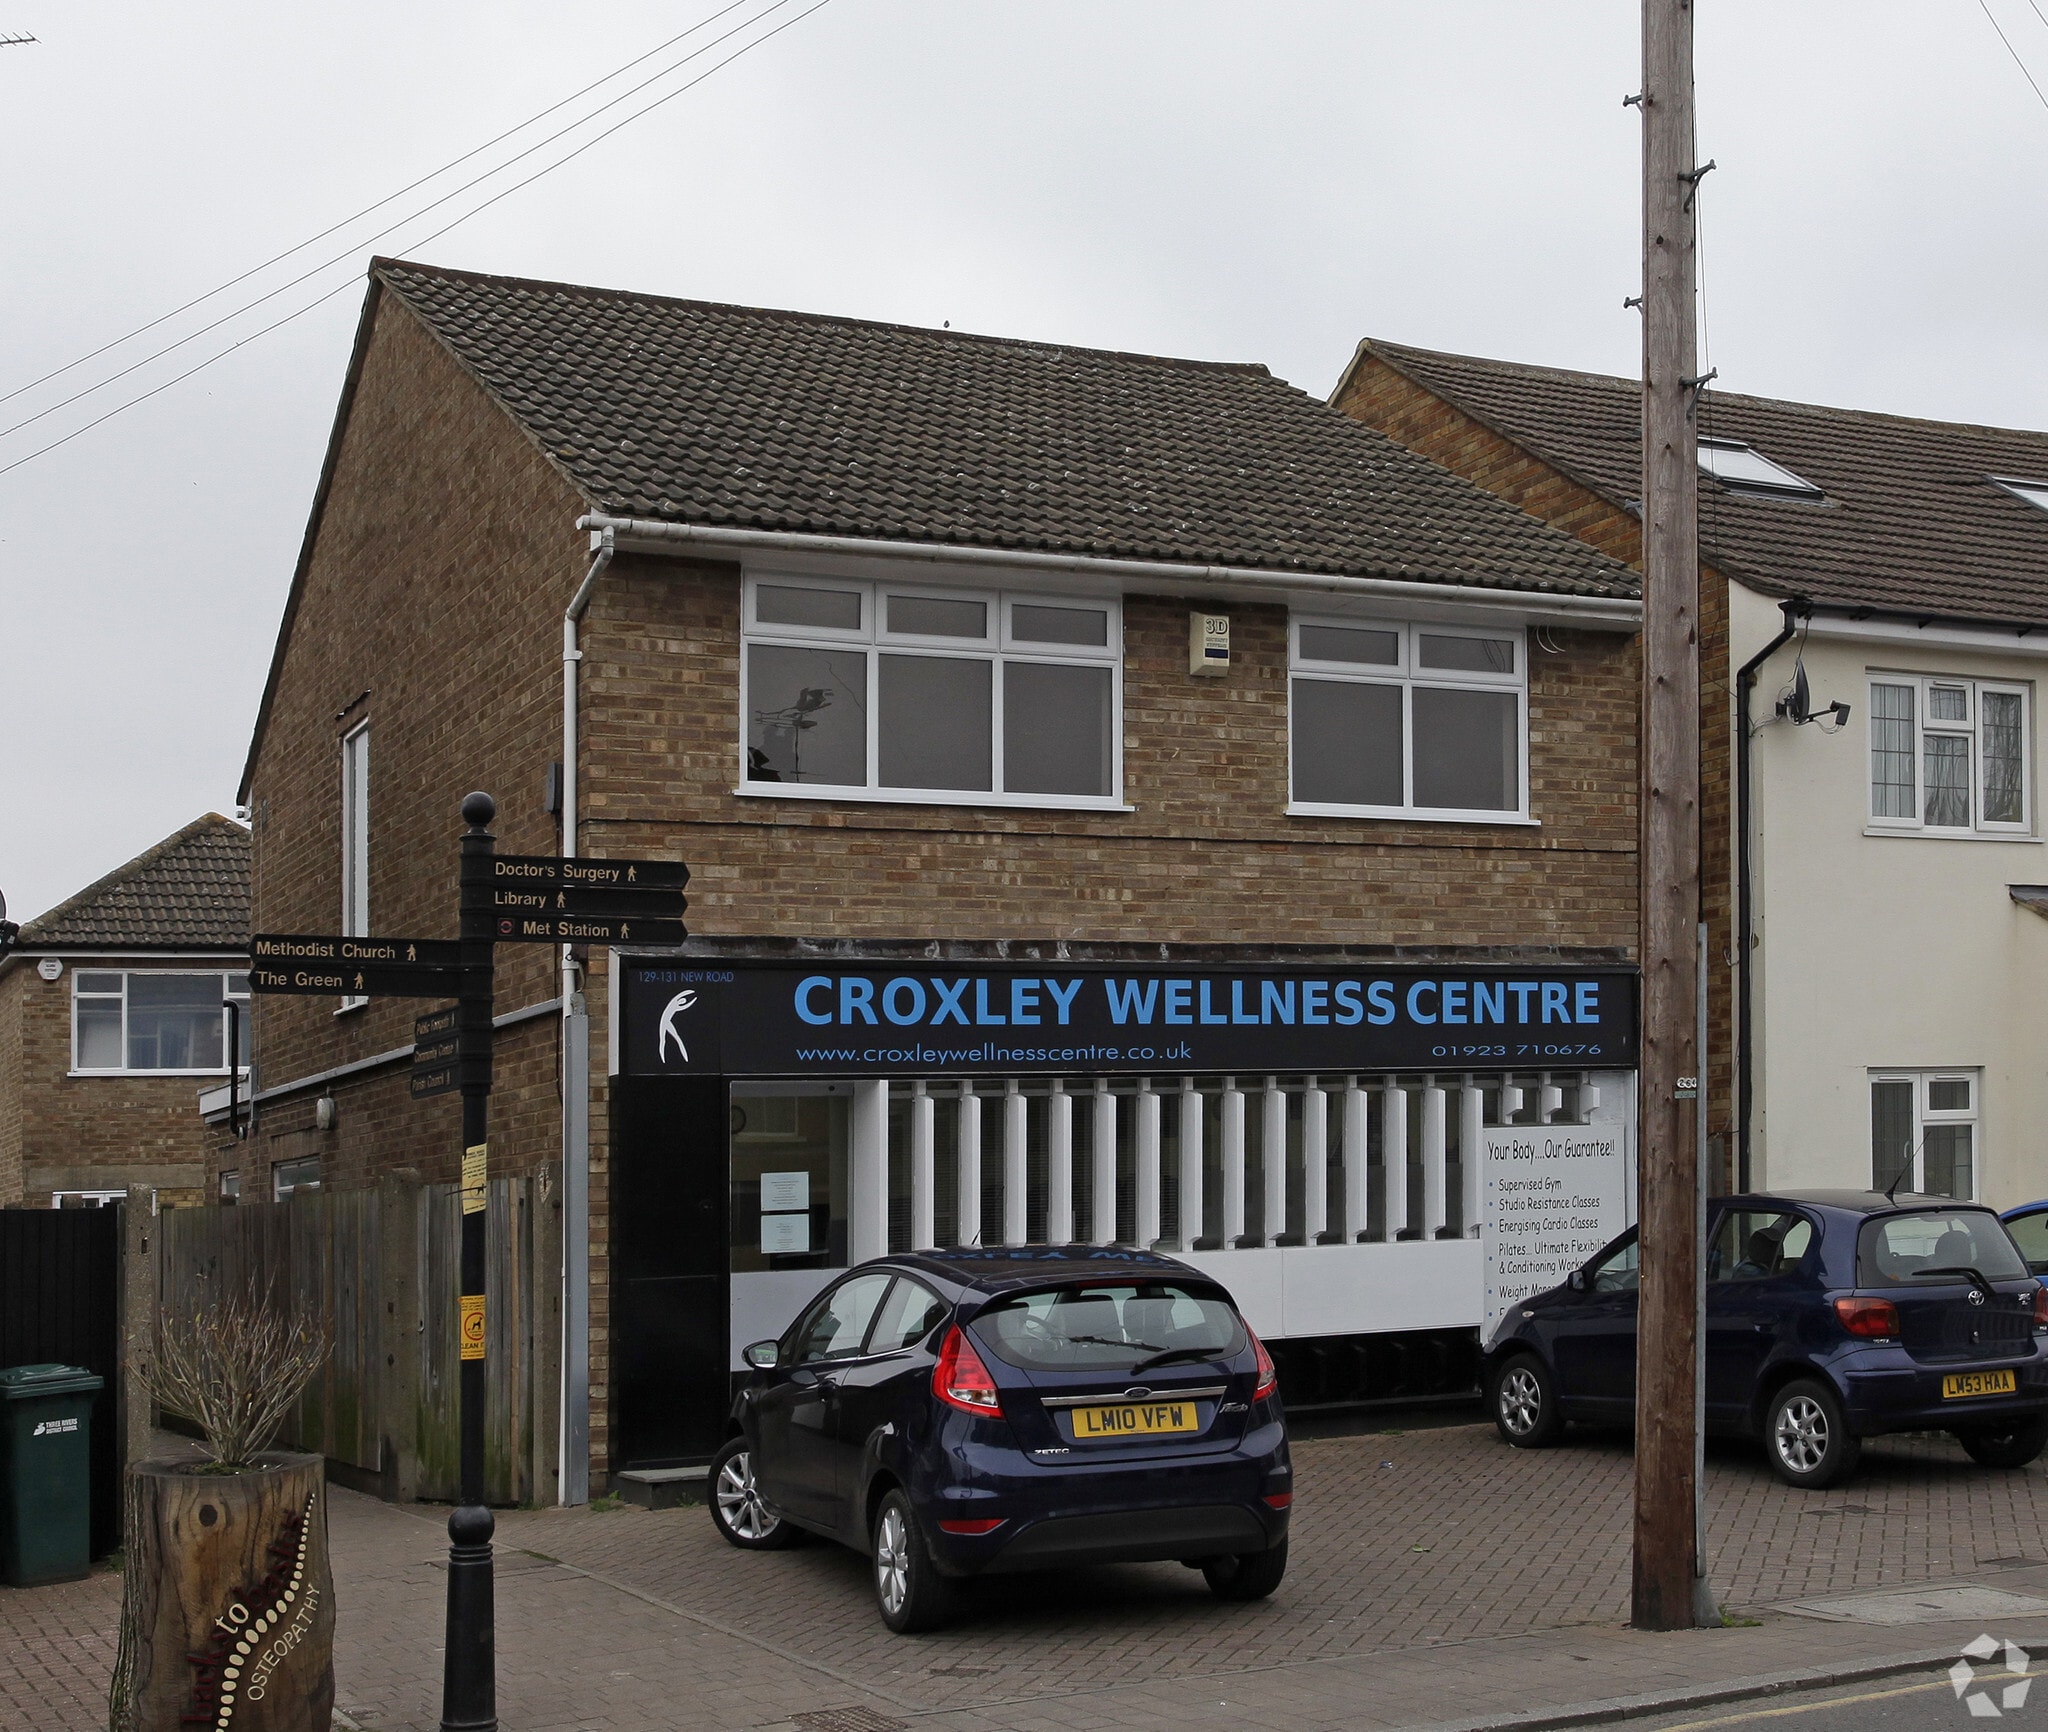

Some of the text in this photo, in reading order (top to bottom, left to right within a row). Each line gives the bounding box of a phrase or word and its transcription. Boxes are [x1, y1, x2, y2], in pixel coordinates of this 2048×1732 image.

[1206, 618, 1228, 634] 3D
[495, 861, 620, 882] Doctor's Surgery
[495, 890, 547, 909] Library
[523, 920, 610, 938] Met Station
[256, 941, 396, 960] Methodist Church
[257, 970, 343, 988] The Green
[638, 970, 734, 983] 129-131 NEW ROAD
[794, 975, 1601, 1026] CROXLEY WELLNESS CENTRE
[1432, 1043, 1602, 1057] 01923 710676
[1487, 1140, 1510, 1161] Your
[1564, 1137, 1615, 1158] Guarantee!!
[1498, 1176, 1562, 1195] Supervised Gym
[1499, 1194, 1600, 1211] Studio Resistance Classes
[1499, 1215, 1599, 1236] Energising Cardio Classes
[1534, 1240, 1569, 1255] Ultimate
[1571, 1238, 1608, 1253] Flexibilit
[1500, 1257, 1585, 1276] & Conditioning Worko
[1499, 1283, 1528, 1302] Weight
[1947, 1372, 2010, 1395] LM53 HAA
[1086, 1405, 1184, 1432] LM10 VFW
[215, 1602, 249, 1635] to
[247, 1583, 320, 1701] OSTEOPATHY
